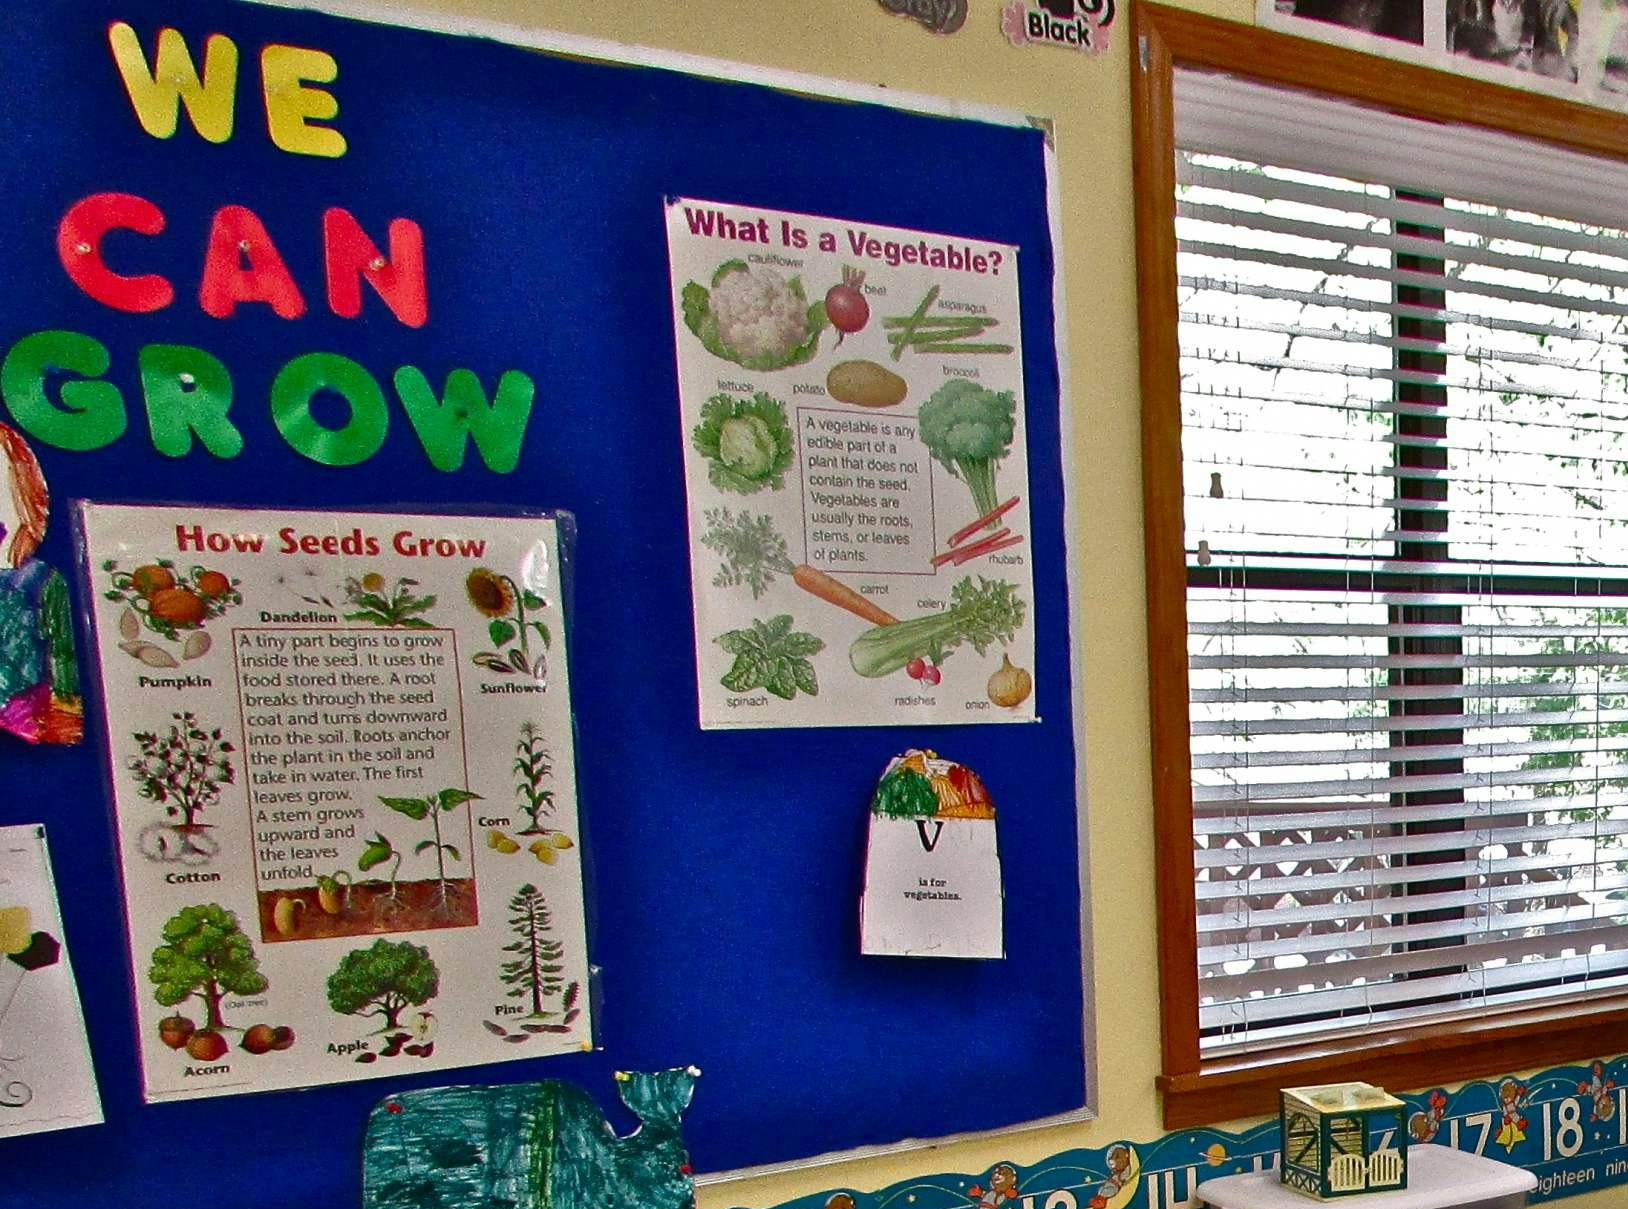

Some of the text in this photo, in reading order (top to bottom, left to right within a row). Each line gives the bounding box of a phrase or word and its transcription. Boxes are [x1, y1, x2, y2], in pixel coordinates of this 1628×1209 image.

[1028, 12, 1091, 46] Black
[108, 20, 348, 159] WE
[685, 207, 1003, 276] What Is a Vegetable?
[57, 191, 428, 330] CAN
[938, 299, 987, 314] asparagus
[943, 365, 980, 378] broccoli
[717, 378, 753, 393] lettuce
[792, 382, 826, 398] potato
[1, 330, 535, 475] GROW
[807, 416, 915, 439] A vegetable is any
[807, 436, 896, 454] edible part of a
[809, 456, 918, 473] plant that does not
[810, 475, 911, 491] contain the seed.
[811, 491, 899, 508] Vegetables are
[812, 512, 912, 528] usually the roots,
[175, 524, 487, 558] How Seeds Grow
[813, 530, 910, 545] stems, or leaves
[814, 548, 868, 563] of plants.
[859, 584, 889, 595] carrot
[917, 598, 946, 611] celery
[260, 611, 337, 623] Dandelion
[240, 634, 444, 650] A tiny part begins to grow
[242, 653, 444, 667] inside the seed. It uses the
[138, 675, 212, 690] Pumpkin
[244, 672, 435, 686] food stored there. A root
[480, 682, 548, 695] Sunflower
[244, 690, 434, 708] breaks through the seed
[727, 695, 768, 708] spinach
[895, 694, 936, 707] radishes
[965, 700, 990, 711] onion
[247, 709, 447, 725] coat and turns downward
[249, 728, 450, 745] into the soil. Roots anchor
[251, 747, 435, 767] the plant in the soil and
[253, 766, 423, 785] take in water. The first
[254, 790, 352, 805] leaves grow.
[256, 807, 364, 824] A stem grows
[478, 815, 510, 827] Corn
[258, 825, 355, 845] upward and
[916, 820, 944, 852] V
[260, 845, 338, 861] the leaves
[166, 870, 221, 884] Cotton
[919, 877, 946, 887] is for
[904, 891, 962, 900] vegetables.
[494, 1003, 524, 1016] Pine
[327, 1039, 369, 1055] Apple
[184, 1063, 230, 1077] Acorn
[1450, 1112, 1493, 1157] 17
[1542, 1097, 1584, 1161] 18
